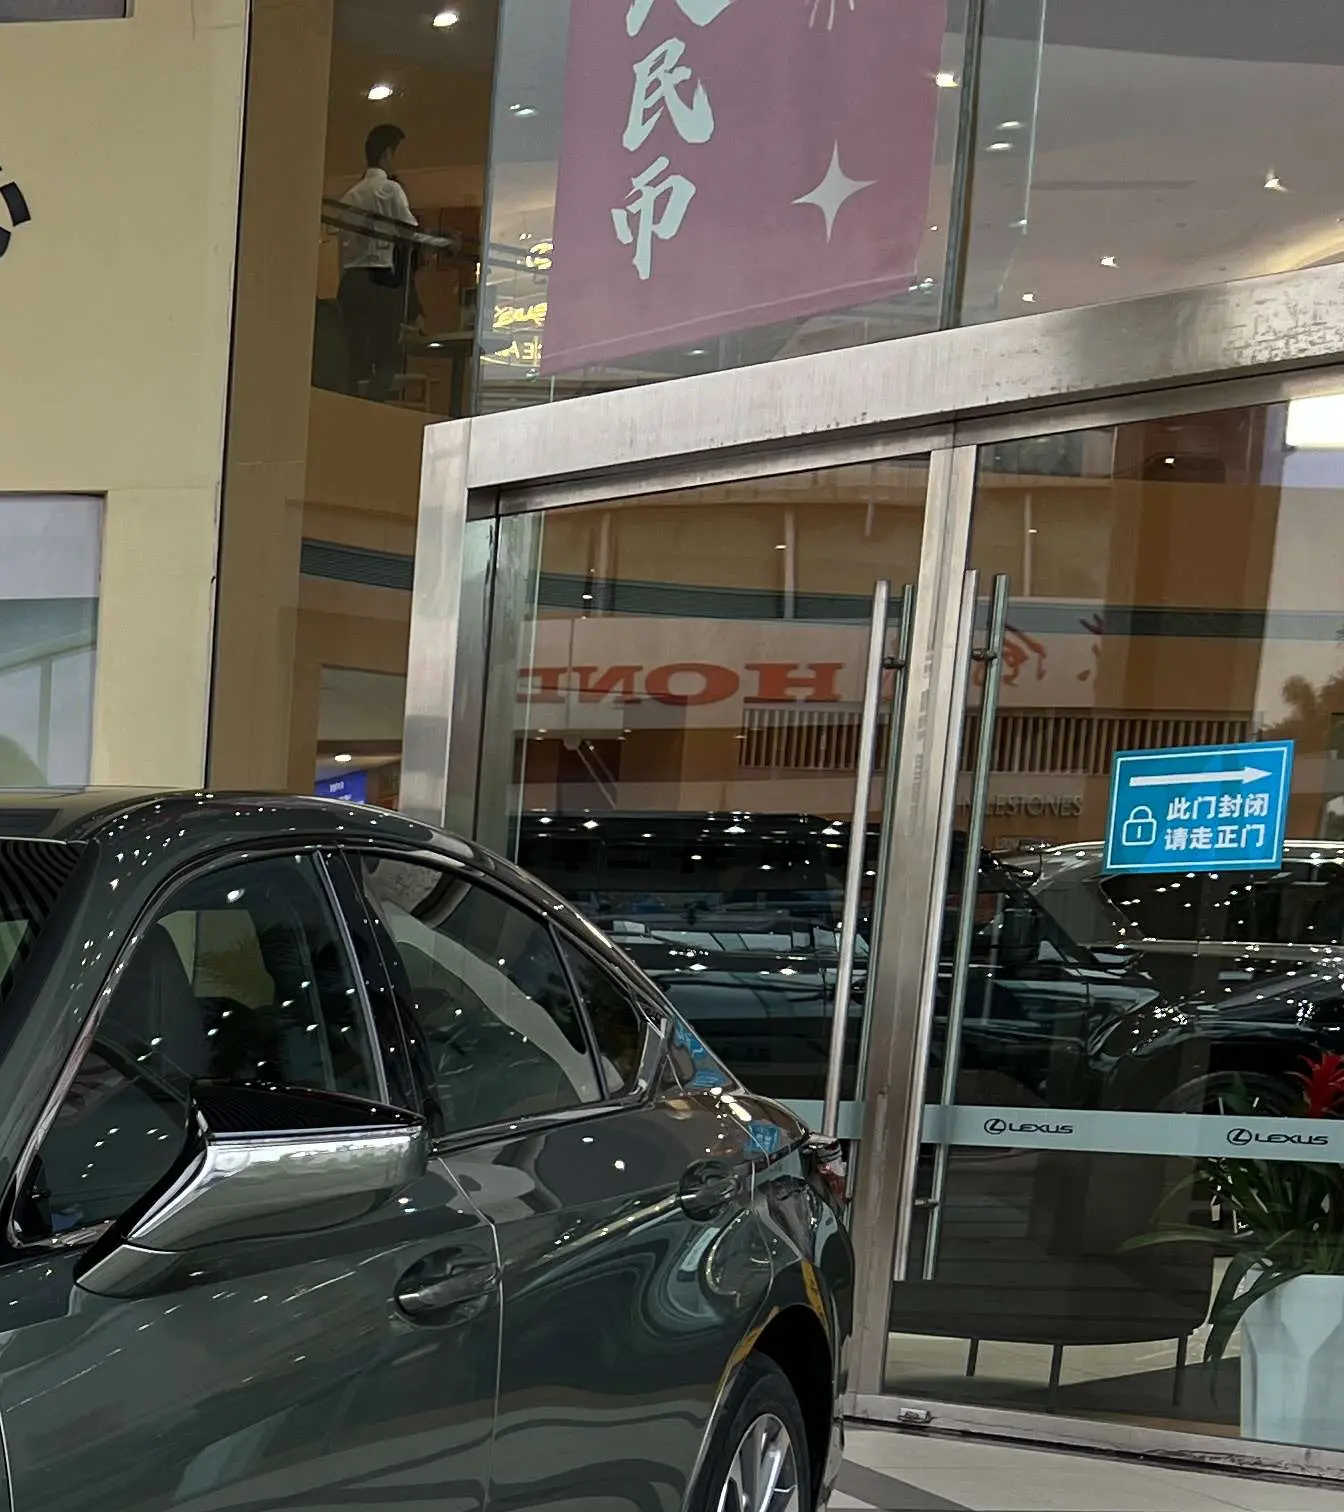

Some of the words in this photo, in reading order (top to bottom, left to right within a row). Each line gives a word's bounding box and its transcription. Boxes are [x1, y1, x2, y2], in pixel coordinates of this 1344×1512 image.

[1166, 793, 1269, 820] 此门封闭
[1164, 824, 1266, 850] 请走正门
[1009, 1123, 1074, 1135] LEXUS
[1255, 1133, 1329, 1146] LEXUS
